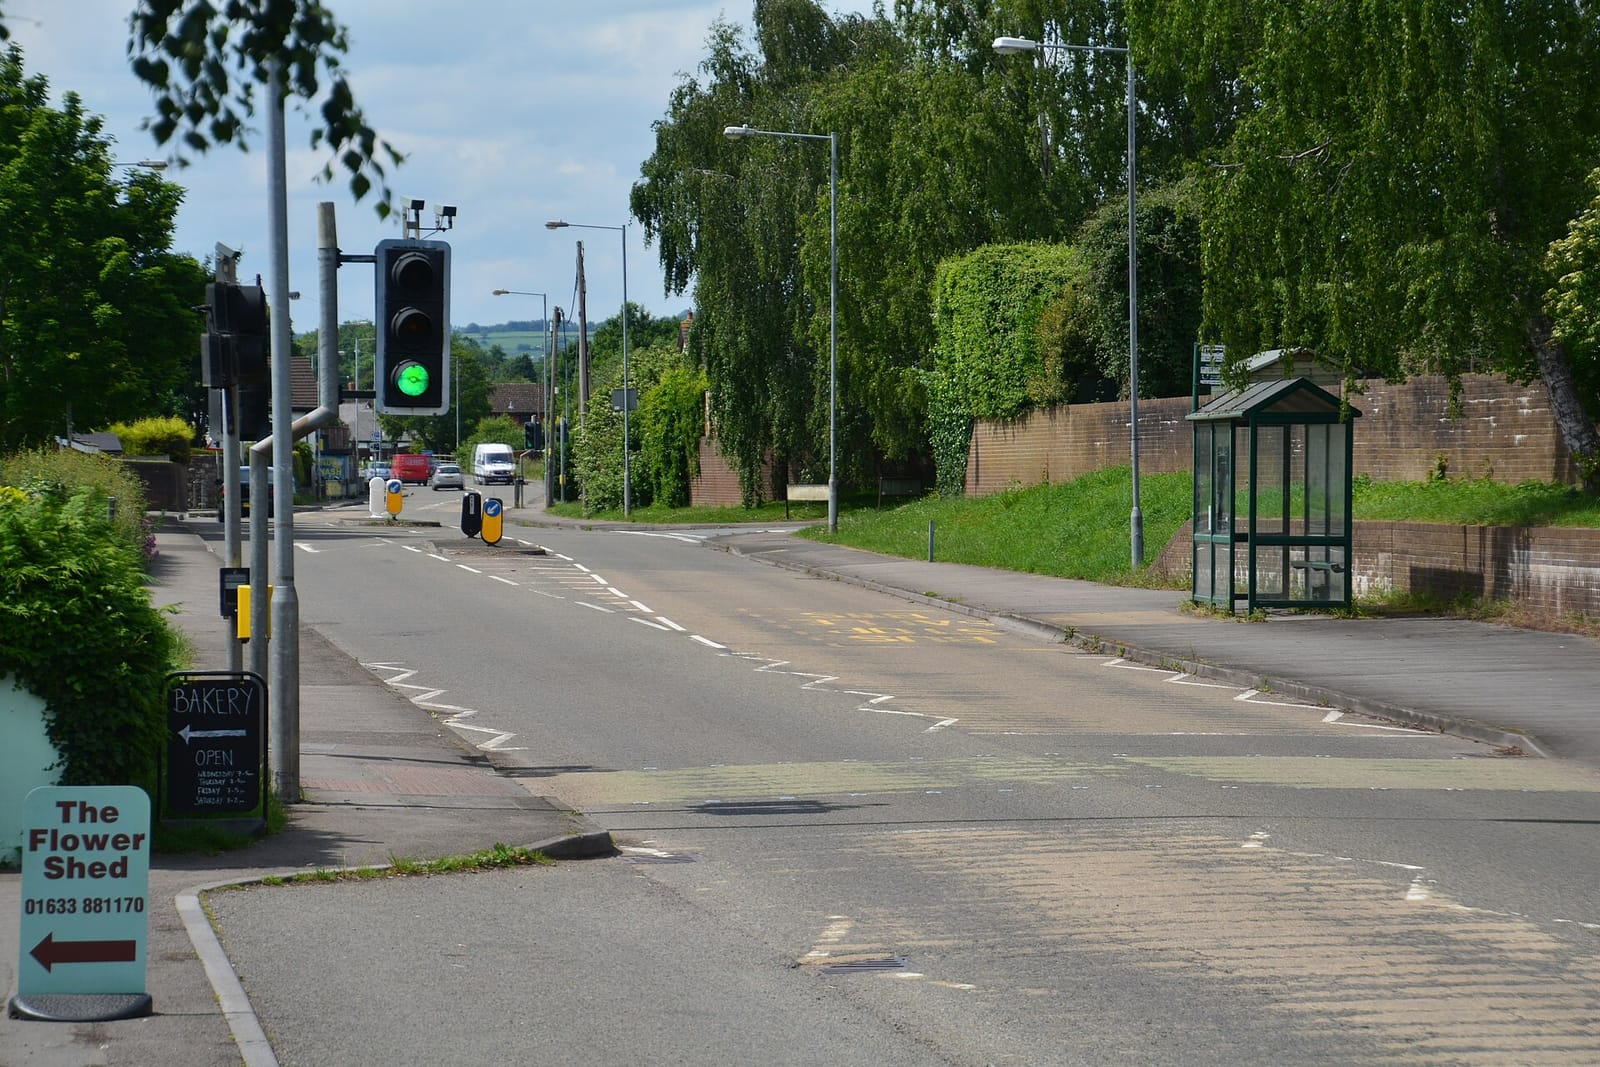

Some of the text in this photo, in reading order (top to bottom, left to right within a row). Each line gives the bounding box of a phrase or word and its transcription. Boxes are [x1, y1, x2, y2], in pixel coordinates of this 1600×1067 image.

[174, 687, 254, 715] BAKERY
[195, 749, 233, 766] OPEN
[197, 786, 221, 795] FRIDAY
[55, 800, 119, 824] The
[29, 828, 145, 852] Flower
[43, 855, 129, 880] Shed
[24, 896, 144, 915] 01633 881170
